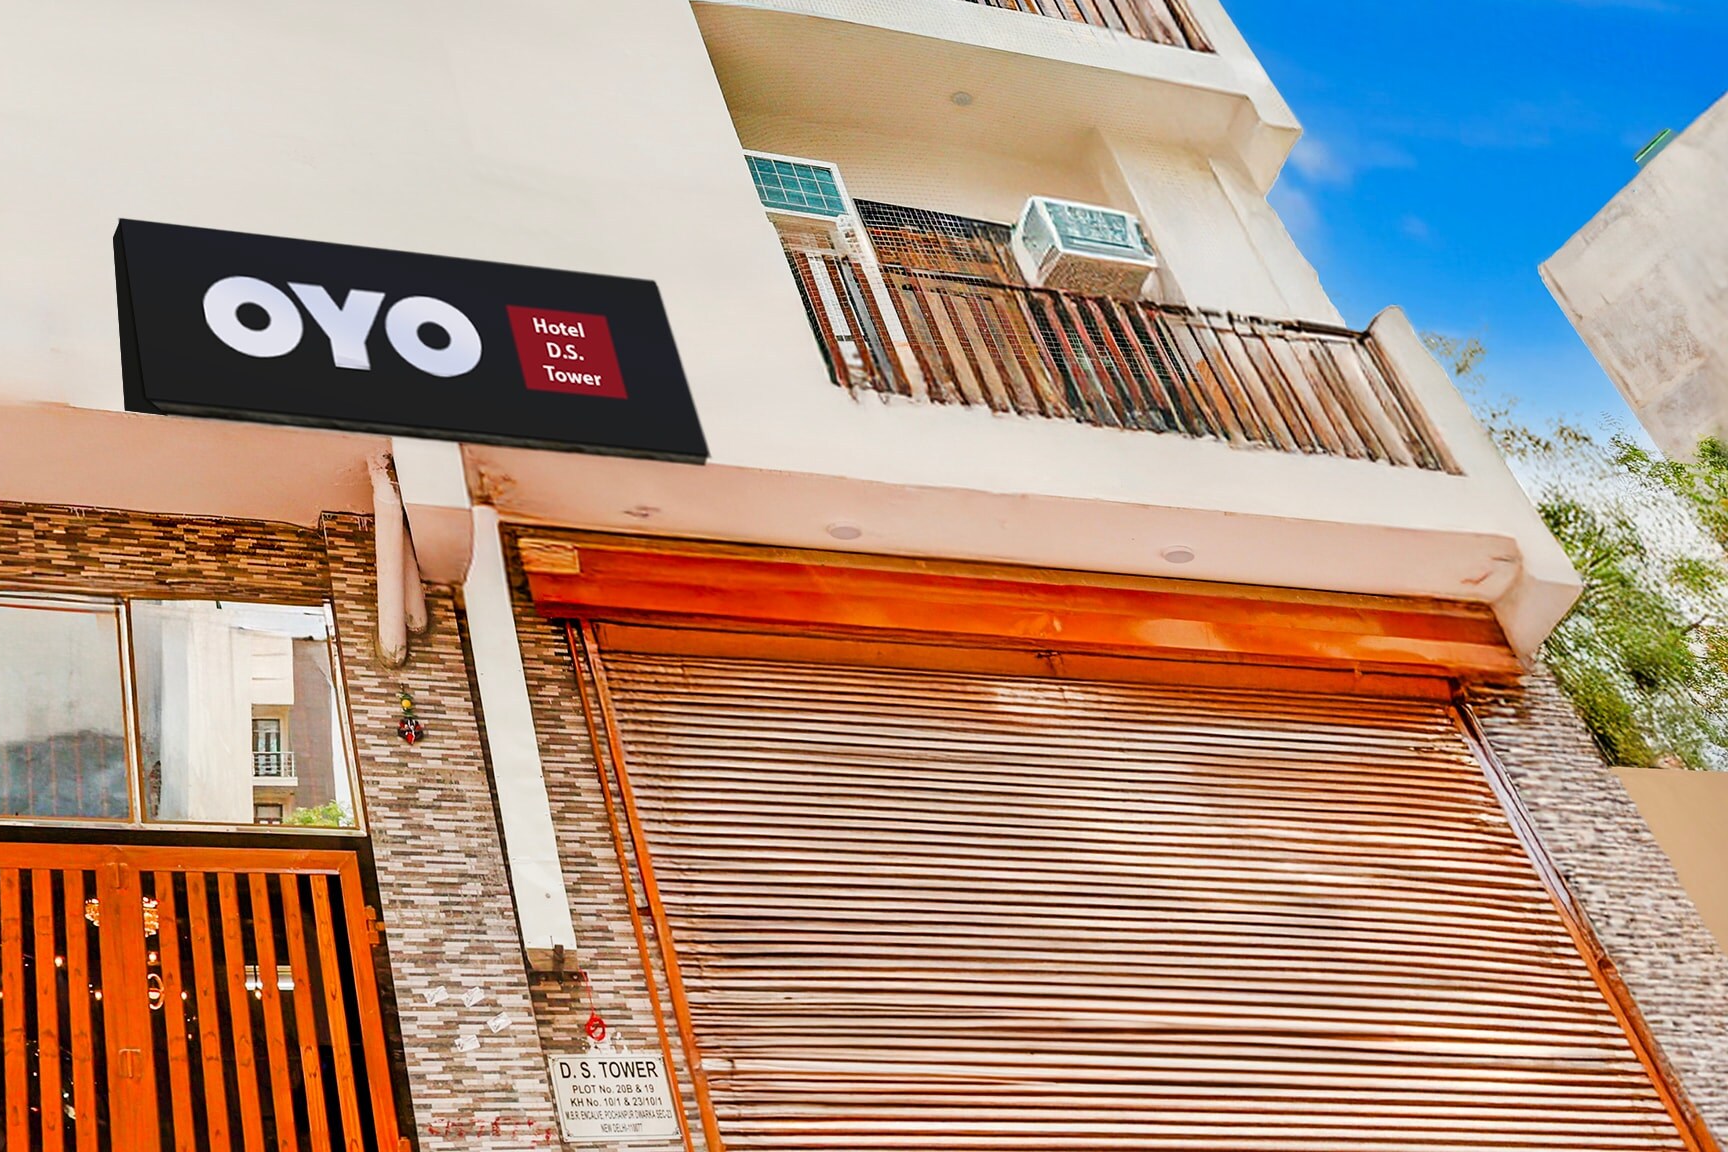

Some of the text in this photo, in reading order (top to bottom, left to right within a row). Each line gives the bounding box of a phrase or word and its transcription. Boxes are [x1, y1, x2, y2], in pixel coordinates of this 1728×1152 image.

[202, 275, 483, 378] OYO
[532, 316, 586, 338] Hotel
[545, 341, 585, 361] D.S.
[542, 364, 602, 386] Tower
[559, 1060, 659, 1079] D. S. TOWER
[572, 1083, 655, 1094] PLOT No. 20B & 19
[570, 1097, 584, 1108] KH
[586, 1097, 602, 1107] No.
[623, 1096, 631, 1106] &
